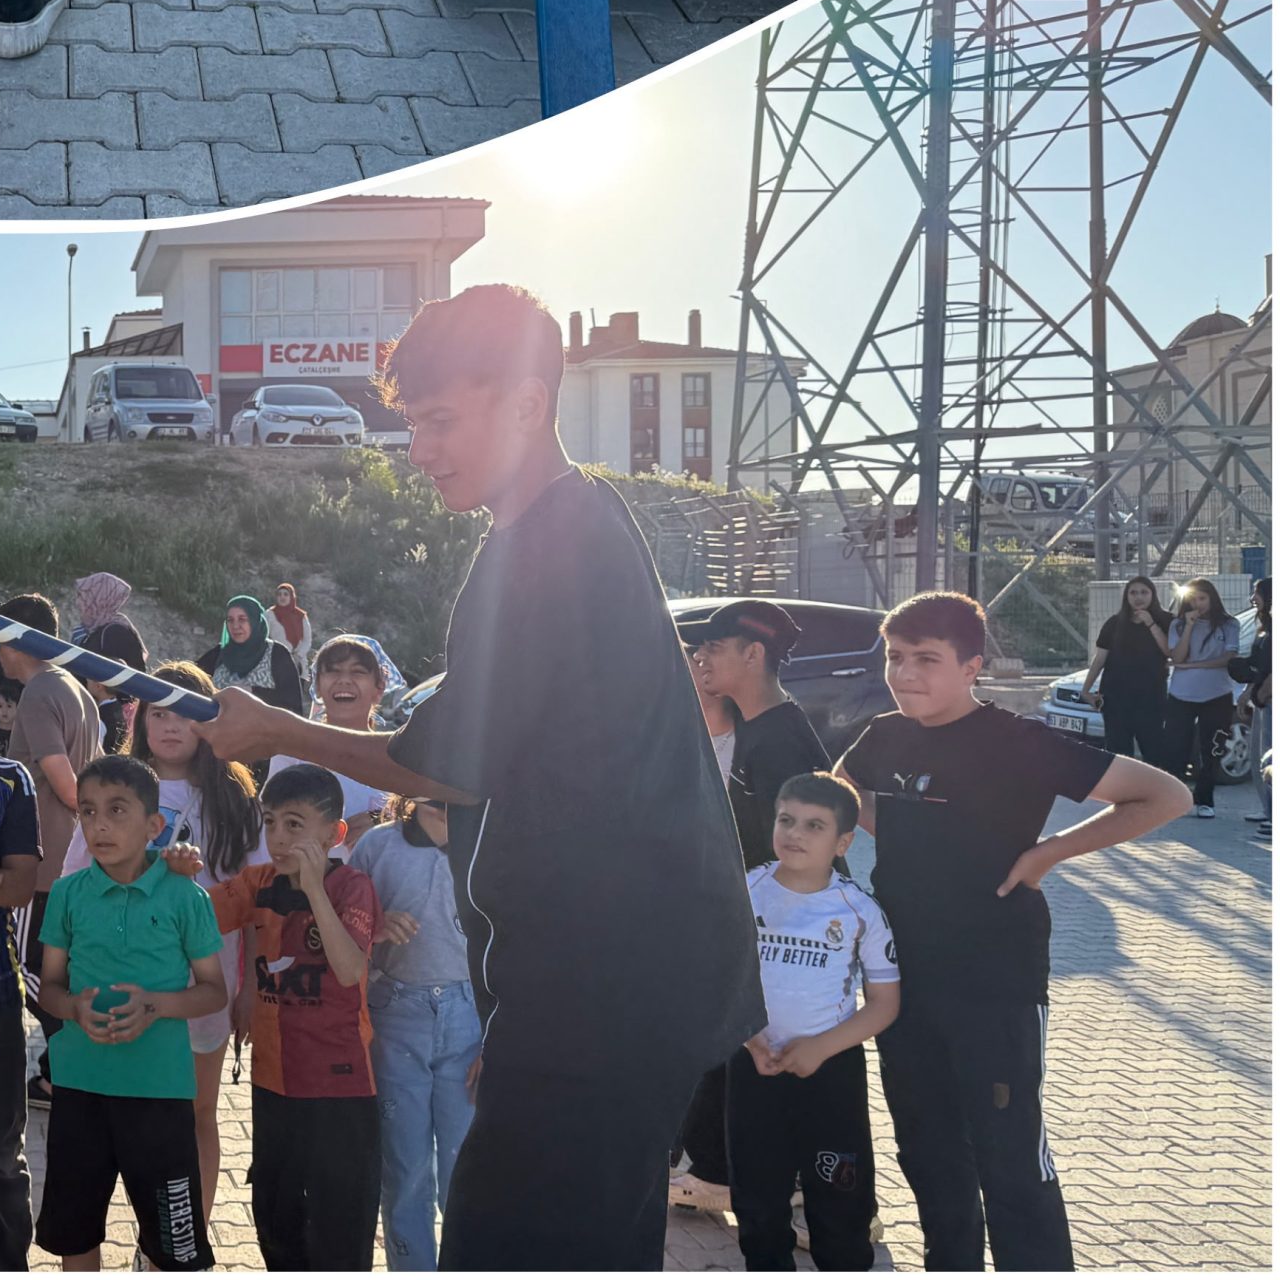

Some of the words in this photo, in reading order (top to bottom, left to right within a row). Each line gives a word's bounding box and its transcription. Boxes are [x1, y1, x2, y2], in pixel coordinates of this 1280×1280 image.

[269, 342, 369, 363] ECZANE
[760, 945, 780, 962] FLY
[782, 948, 829, 969] BETTER
[167, 1176, 198, 1263] INTERESTING
